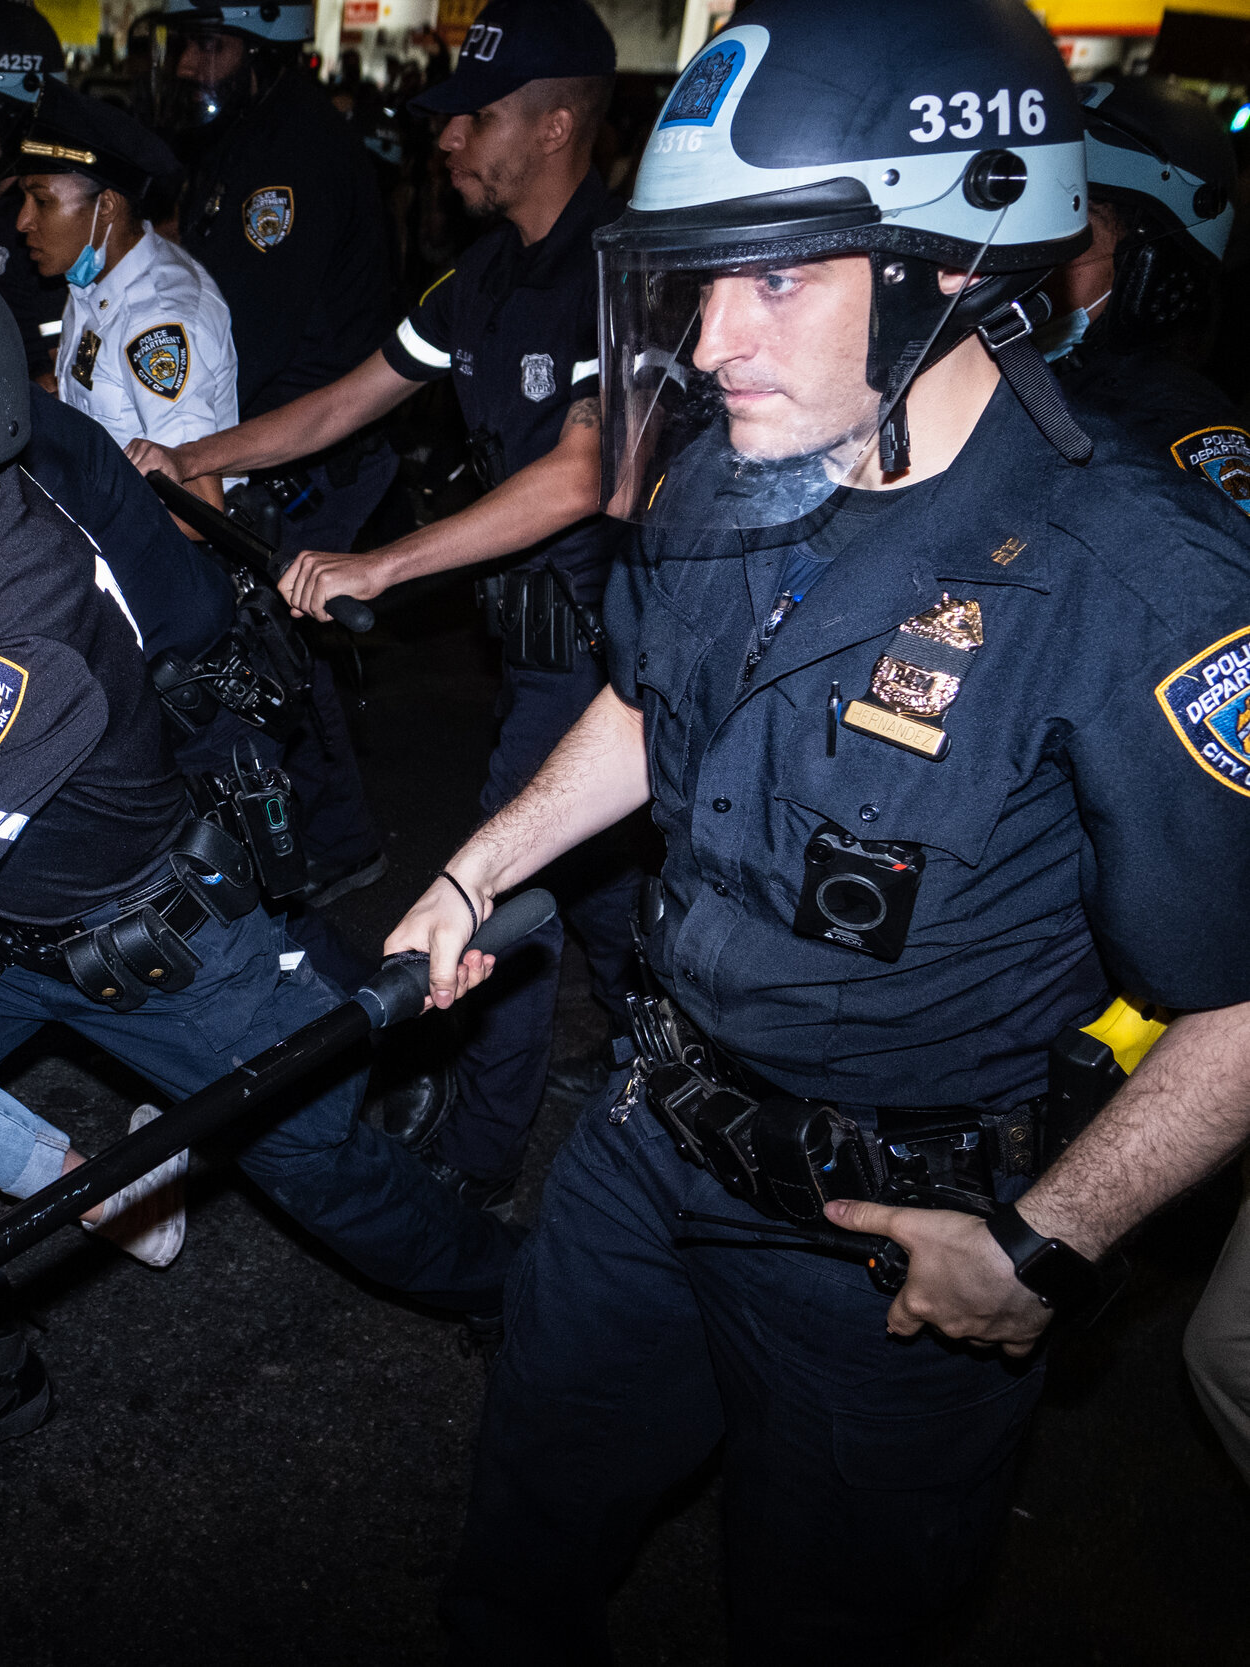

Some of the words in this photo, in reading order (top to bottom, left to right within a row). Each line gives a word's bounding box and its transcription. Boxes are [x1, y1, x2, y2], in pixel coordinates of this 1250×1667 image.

[461, 24, 503, 62] PD
[909, 88, 1046, 143] 3316
[653, 129, 704, 154] 3316
[133, 336, 181, 362] DEPARTMENT
[139, 329, 169, 347] POLICE
[152, 382, 165, 392] OF
[1202, 432, 1245, 448] POLICE
[1201, 641, 1250, 686] POLI
[1186, 667, 1250, 725] DEPAR
[851, 706, 935, 748] HERNANDEZ
[1202, 742, 1245, 777] CITY
[834, 935, 863, 947] AXON
